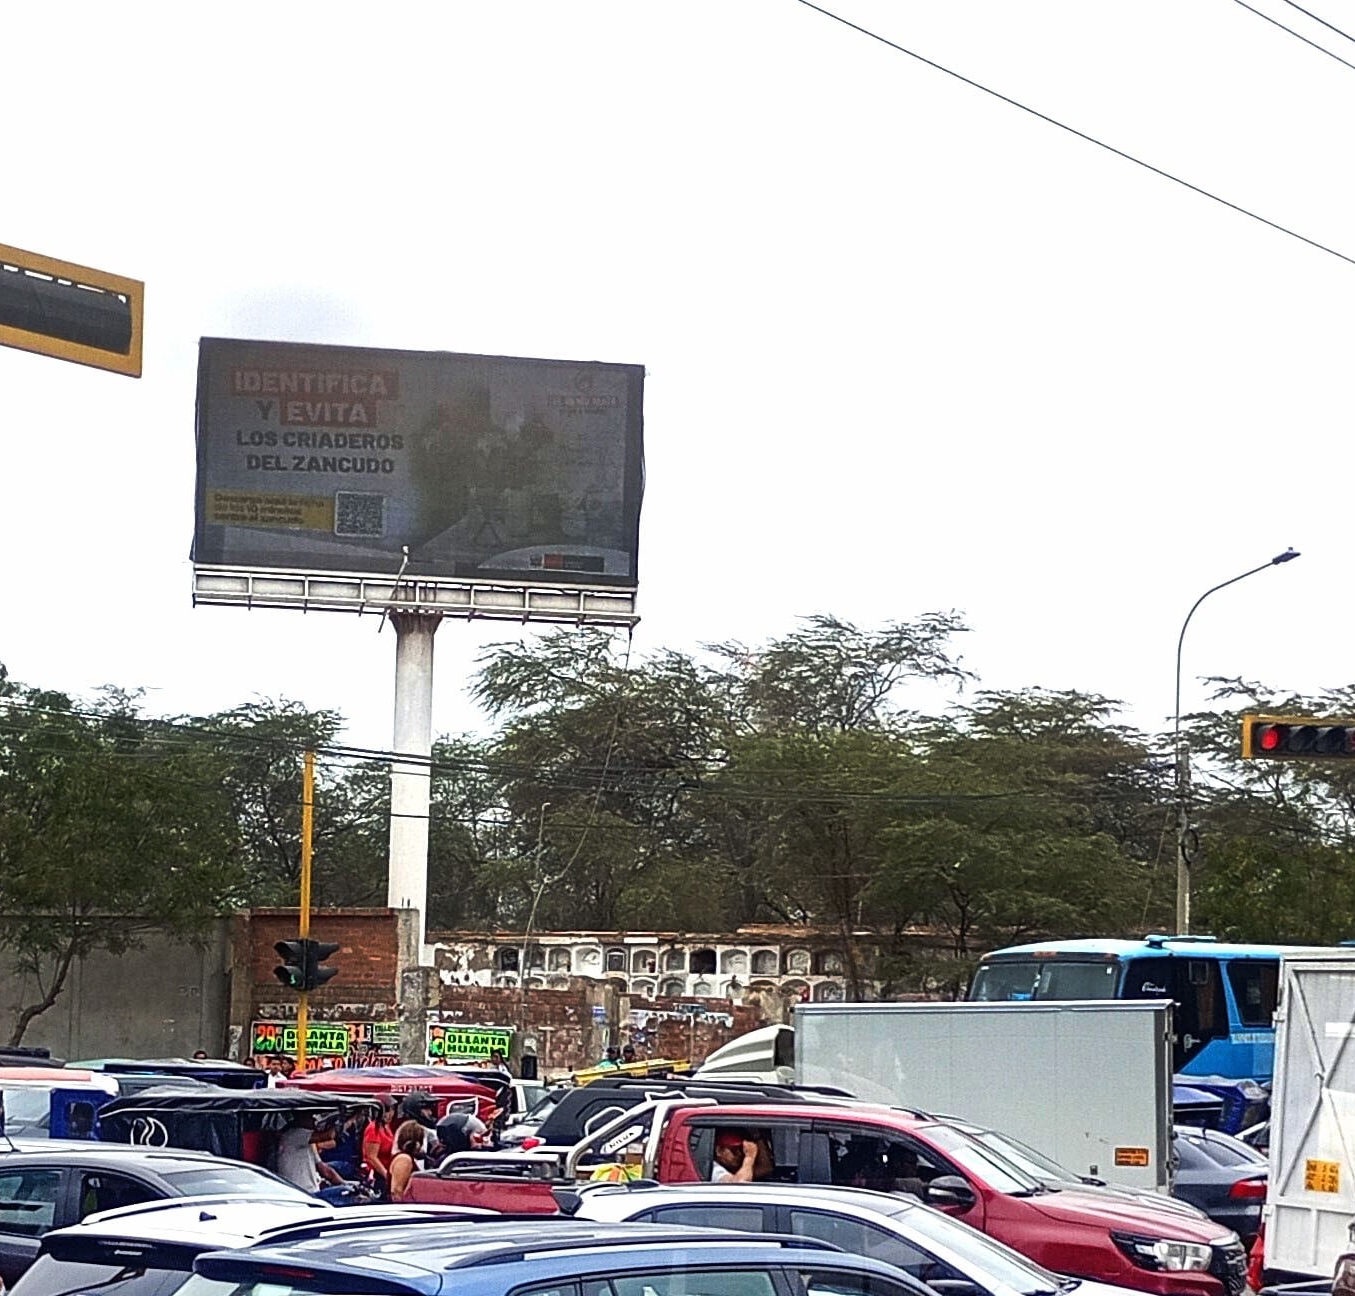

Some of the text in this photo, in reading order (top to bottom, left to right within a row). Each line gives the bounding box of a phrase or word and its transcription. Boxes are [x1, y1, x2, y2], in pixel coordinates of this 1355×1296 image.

[234, 371, 388, 395] IDENTIFICA
[255, 400, 368, 423] Y EVITA
[236, 430, 404, 450] LOS CRIADEROS
[246, 454, 394, 474] DEL ZANCUDO
[287, 1030, 345, 1041] OLANTA
[287, 1040, 345, 1050] HMALA
[447, 1034, 506, 1046] OLLANTA
